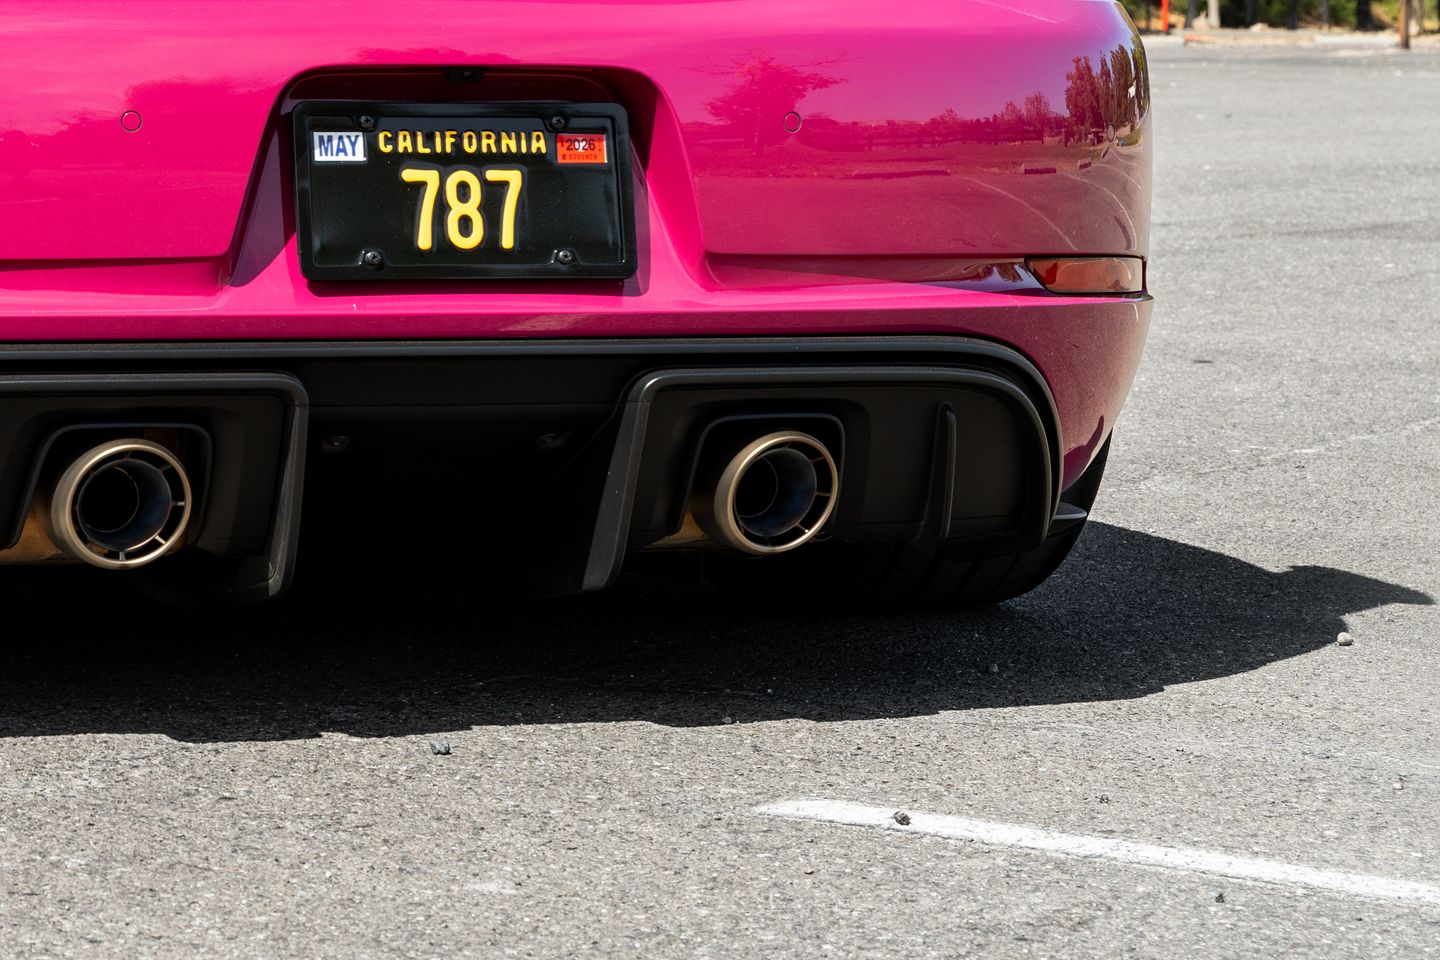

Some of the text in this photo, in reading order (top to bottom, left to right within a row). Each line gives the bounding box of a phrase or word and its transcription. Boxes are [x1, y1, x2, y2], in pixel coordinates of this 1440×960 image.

[318, 134, 360, 157] MAY
[378, 130, 547, 154] CALIFORNIA
[565, 137, 596, 151] 2026
[401, 168, 523, 251] 787
